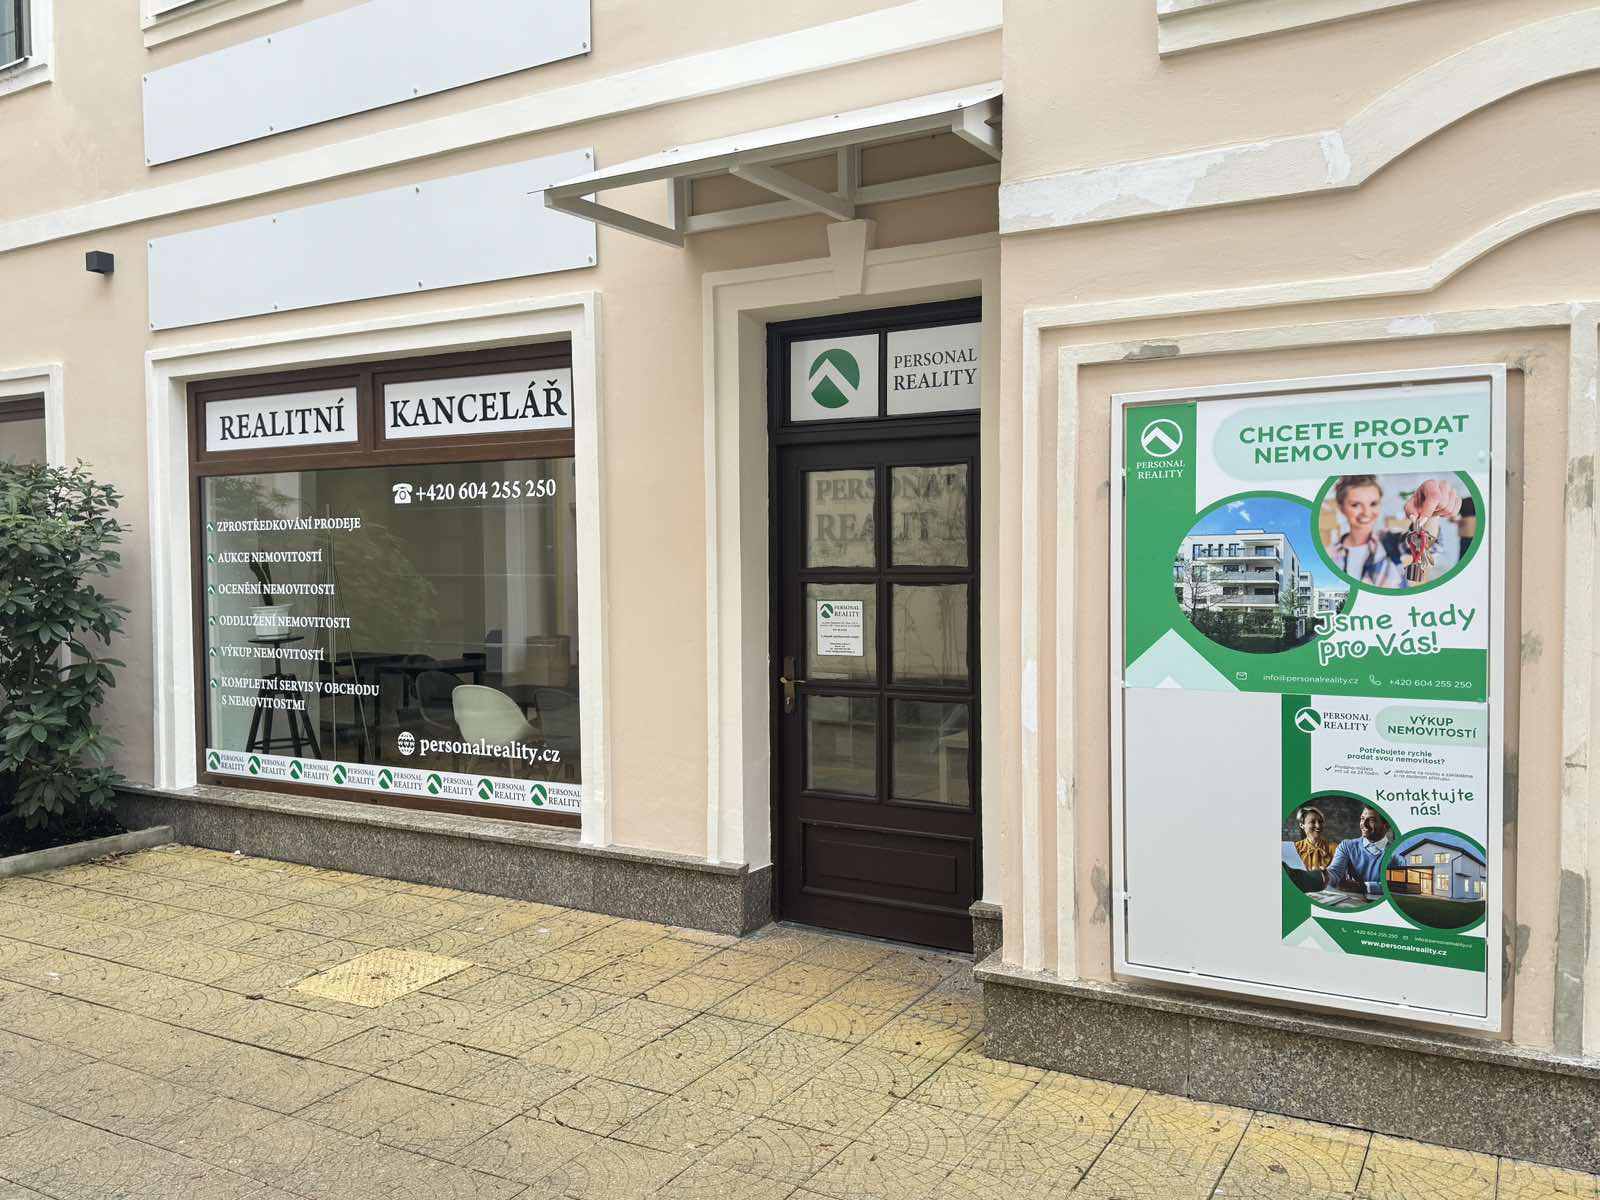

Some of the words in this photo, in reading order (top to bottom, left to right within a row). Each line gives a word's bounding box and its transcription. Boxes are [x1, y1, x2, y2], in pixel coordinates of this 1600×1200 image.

[894, 348, 977, 369] PERSONAL
[894, 368, 977, 391] REALITY
[219, 397, 345, 440] REALITNÍ
[390, 378, 567, 428] KANCELÁŘ
[1239, 422, 1344, 444] CHCETE
[1354, 414, 1470, 438] PRODAT
[1254, 438, 1449, 464] NEMOVITOST?
[1136, 460, 1185, 470] PERSONAL
[1137, 470, 1184, 480] REALITY
[415, 483, 455, 501] +420
[458, 482, 488, 500] 604
[492, 480, 521, 499] 255
[525, 478, 556, 497] 250
[216, 516, 312, 532] ZPROSTŘEDKOVÁNÍ
[314, 517, 361, 532] PRODEJE
[218, 552, 250, 563] AUKCE
[251, 548, 322, 562] NEMOVITOSTÍ
[218, 581, 262, 595] OCENĚNÍ
[263, 584, 335, 595] NEMOVITOSTI
[219, 613, 277, 627] ODDLUŽENÍ
[278, 616, 352, 629] NEMOVITOSTI
[1315, 611, 1392, 635] Jsme
[1408, 604, 1476, 630] tady
[220, 644, 251, 658] VÝKUP
[253, 647, 324, 661] NEMOVITOSTÍ
[1318, 640, 1368, 665] pro
[1375, 629, 1440, 656] Vás!
[220, 676, 278, 690] KOMPLETNÍ
[279, 680, 314, 692] SERVIS
[316, 682, 324, 692] V
[325, 682, 380, 696] OBCHODU
[1263, 674, 1359, 686] info@personalreality.cz
[1414, 679, 1433, 687] 604
[1434, 680, 1452, 688] 255
[1454, 681, 1472, 689] 250
[222, 695, 227, 704] S
[228, 696, 306, 710] NEMOVITOSTMI
[1323, 712, 1371, 721] PERSONAL
[1410, 714, 1454, 726] VÝKUP
[1324, 722, 1370, 731] REALITY
[1388, 726, 1477, 738] NEMOVITOSTÍ
[420, 738, 560, 765] personalreality.cz
[1360, 747, 1406, 757] Potřebujete
[1408, 750, 1432, 758] rychle
[220, 754, 244, 762] PERSONAL
[262, 758, 286, 768] PERSONAL
[1347, 753, 1374, 761] prodat
[1396, 756, 1445, 765] nemovitost?
[220, 762, 245, 771] REALITY
[262, 766, 287, 776] REALITY
[304, 763, 330, 771] PERSONAL
[348, 768, 375, 776] PERSONAL
[304, 771, 330, 780] REALITY
[348, 776, 376, 786] REALITY
[393, 772, 422, 780] PERSONAL
[443, 777, 474, 786] PERSONAL
[393, 781, 422, 790] REALITY
[443, 786, 474, 796] REALITY
[494, 782, 526, 791] PERSONAL
[494, 791, 526, 802] REALITY
[548, 788, 581, 798] PERSONAL
[1376, 788, 1474, 803] Kontaktujte
[549, 797, 581, 808] REALITY
[1410, 802, 1440, 816] nás!
[1360, 939, 1448, 956] www.personalreality.cz
